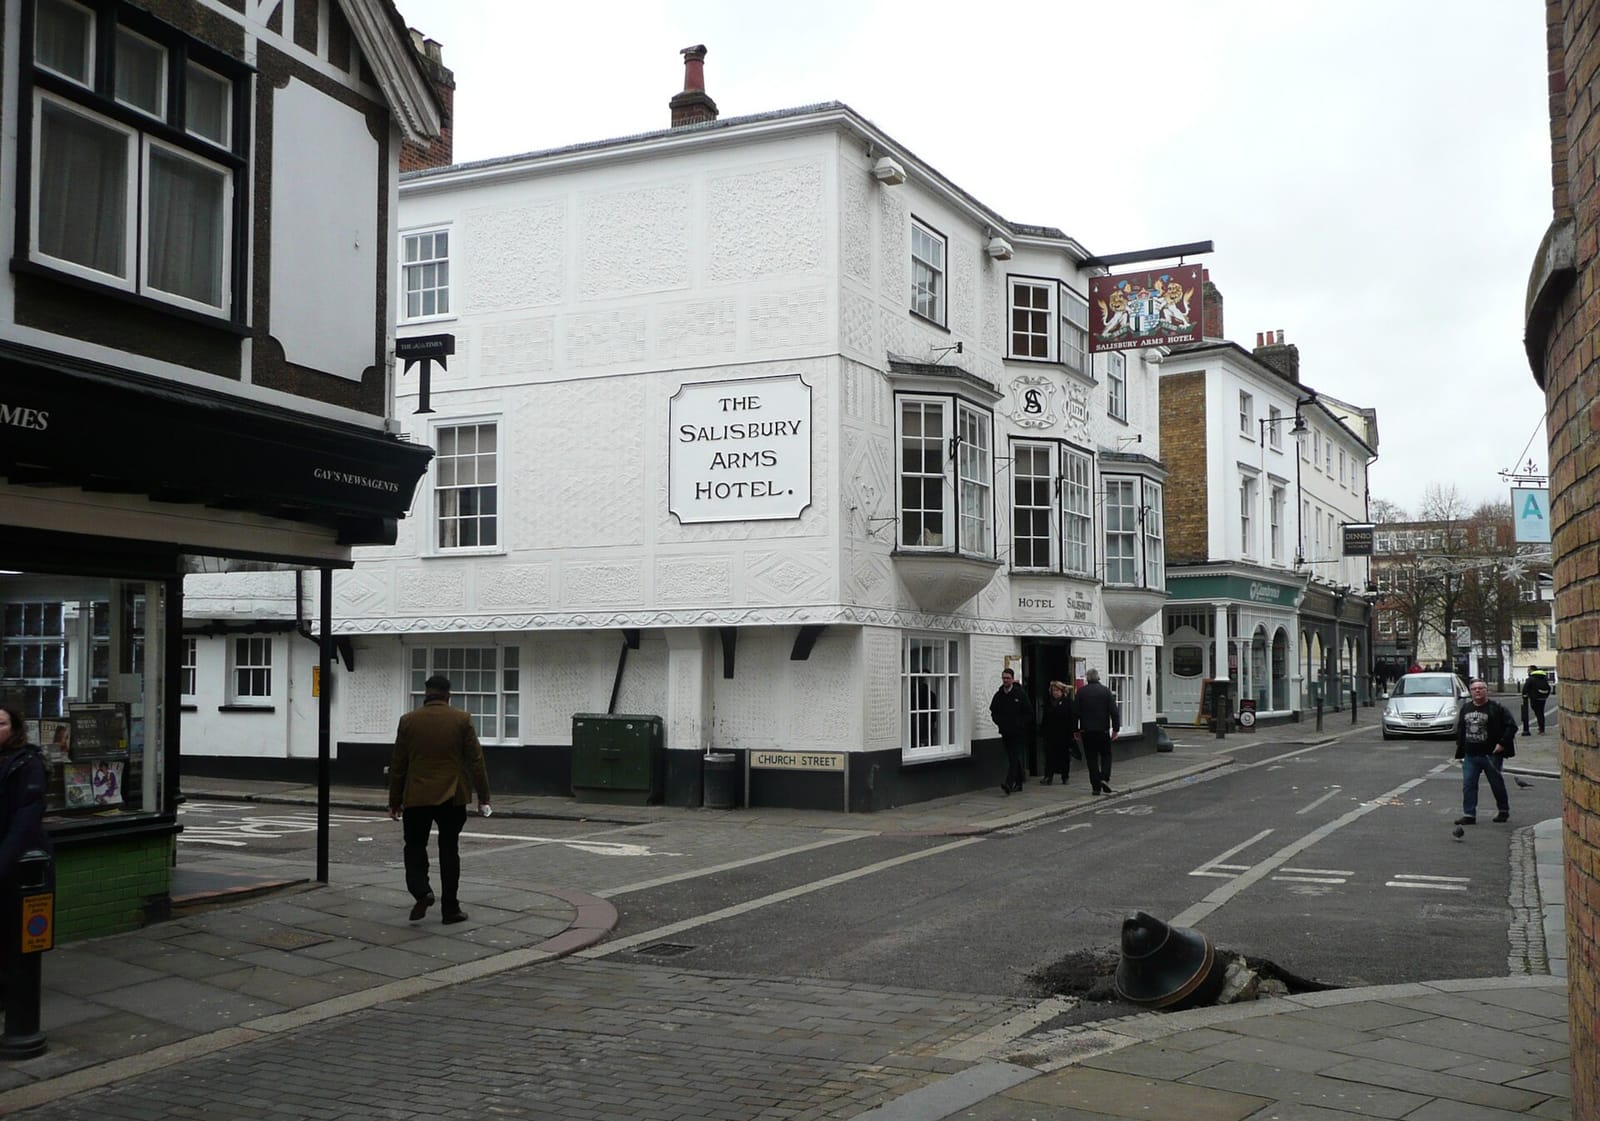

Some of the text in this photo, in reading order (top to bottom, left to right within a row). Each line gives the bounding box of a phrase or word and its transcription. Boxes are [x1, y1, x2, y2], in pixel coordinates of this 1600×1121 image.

[1095, 334, 1194, 351] SALISBURY ARMS HOTEL
[718, 395, 762, 412] THE
[679, 420, 802, 443] SALISBURY
[709, 450, 778, 470] ARMS
[313, 468, 399, 493] GAY'S NEWSAGENTS
[1018, 598, 1055, 608] HOTEL
[758, 754, 837, 767] CHURCH STREET
